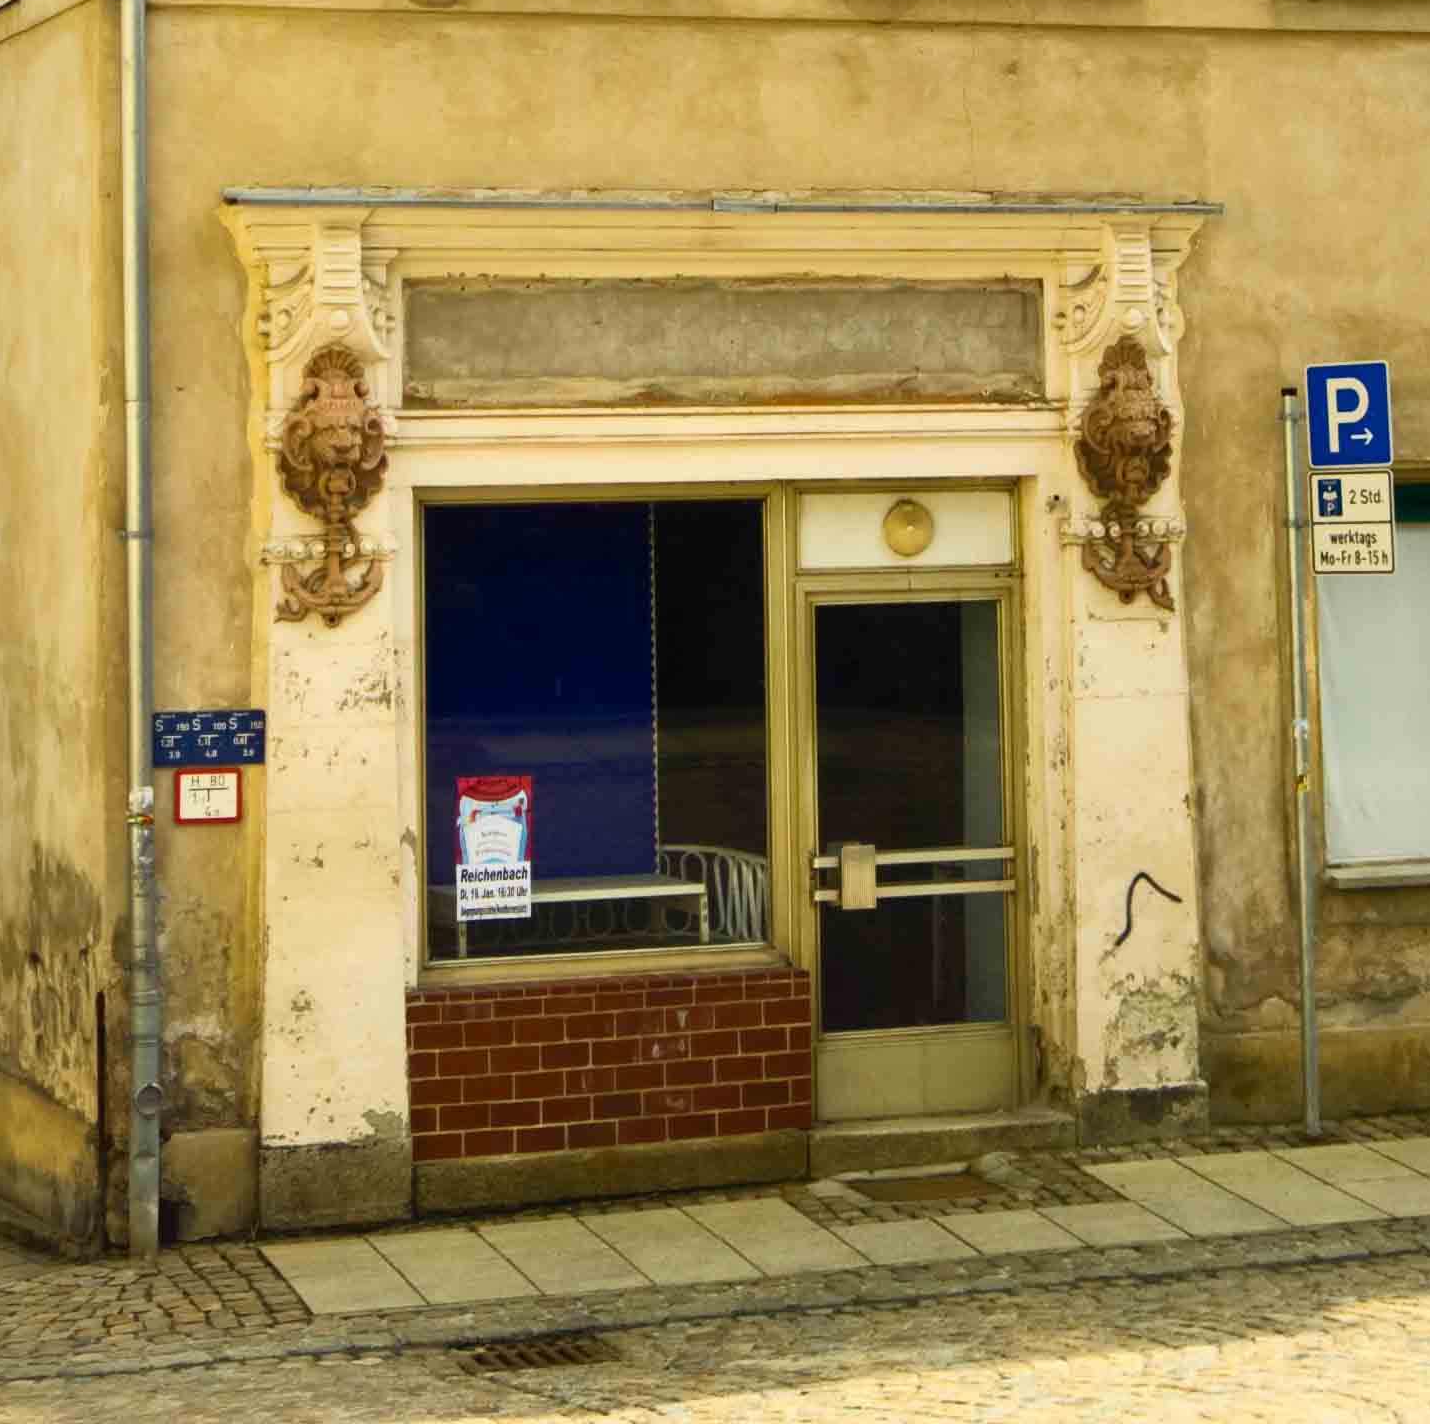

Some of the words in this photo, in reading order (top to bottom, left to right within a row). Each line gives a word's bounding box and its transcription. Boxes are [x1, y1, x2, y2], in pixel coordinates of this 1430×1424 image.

[1326, 377, 1369, 453] P
[1349, 489, 1357, 505] 2
[1329, 529, 1377, 547] werktags
[1320, 551, 1352, 566] Mo-Fr
[1354, 549, 1380, 566] 8-15
[1382, 549, 1388, 564] h
[191, 775, 200, 785] H
[460, 866, 528, 883] Reichenbach
